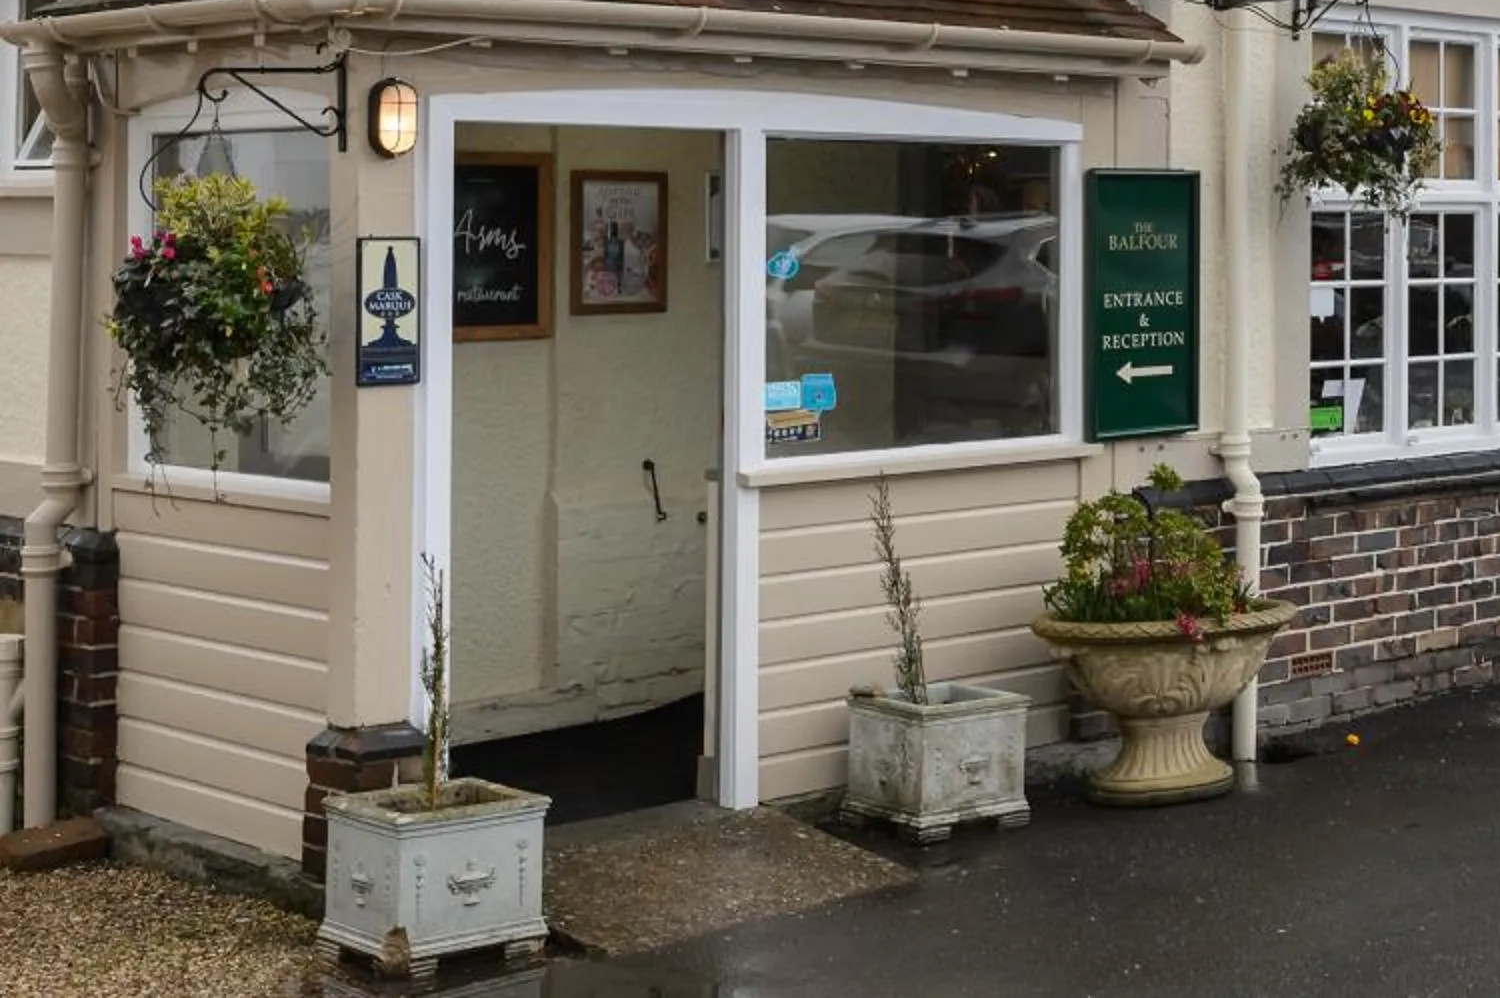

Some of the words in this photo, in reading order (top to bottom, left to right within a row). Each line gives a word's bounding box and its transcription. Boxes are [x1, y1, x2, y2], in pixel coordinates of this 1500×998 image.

[1134, 221, 1153, 233] THE
[1108, 233, 1178, 251] BALFOUR
[376, 291, 403, 301] CASK
[1103, 290, 1184, 309] ENTRANCE
[1139, 313, 1150, 327] &
[1102, 330, 1185, 350] RECEPTION
